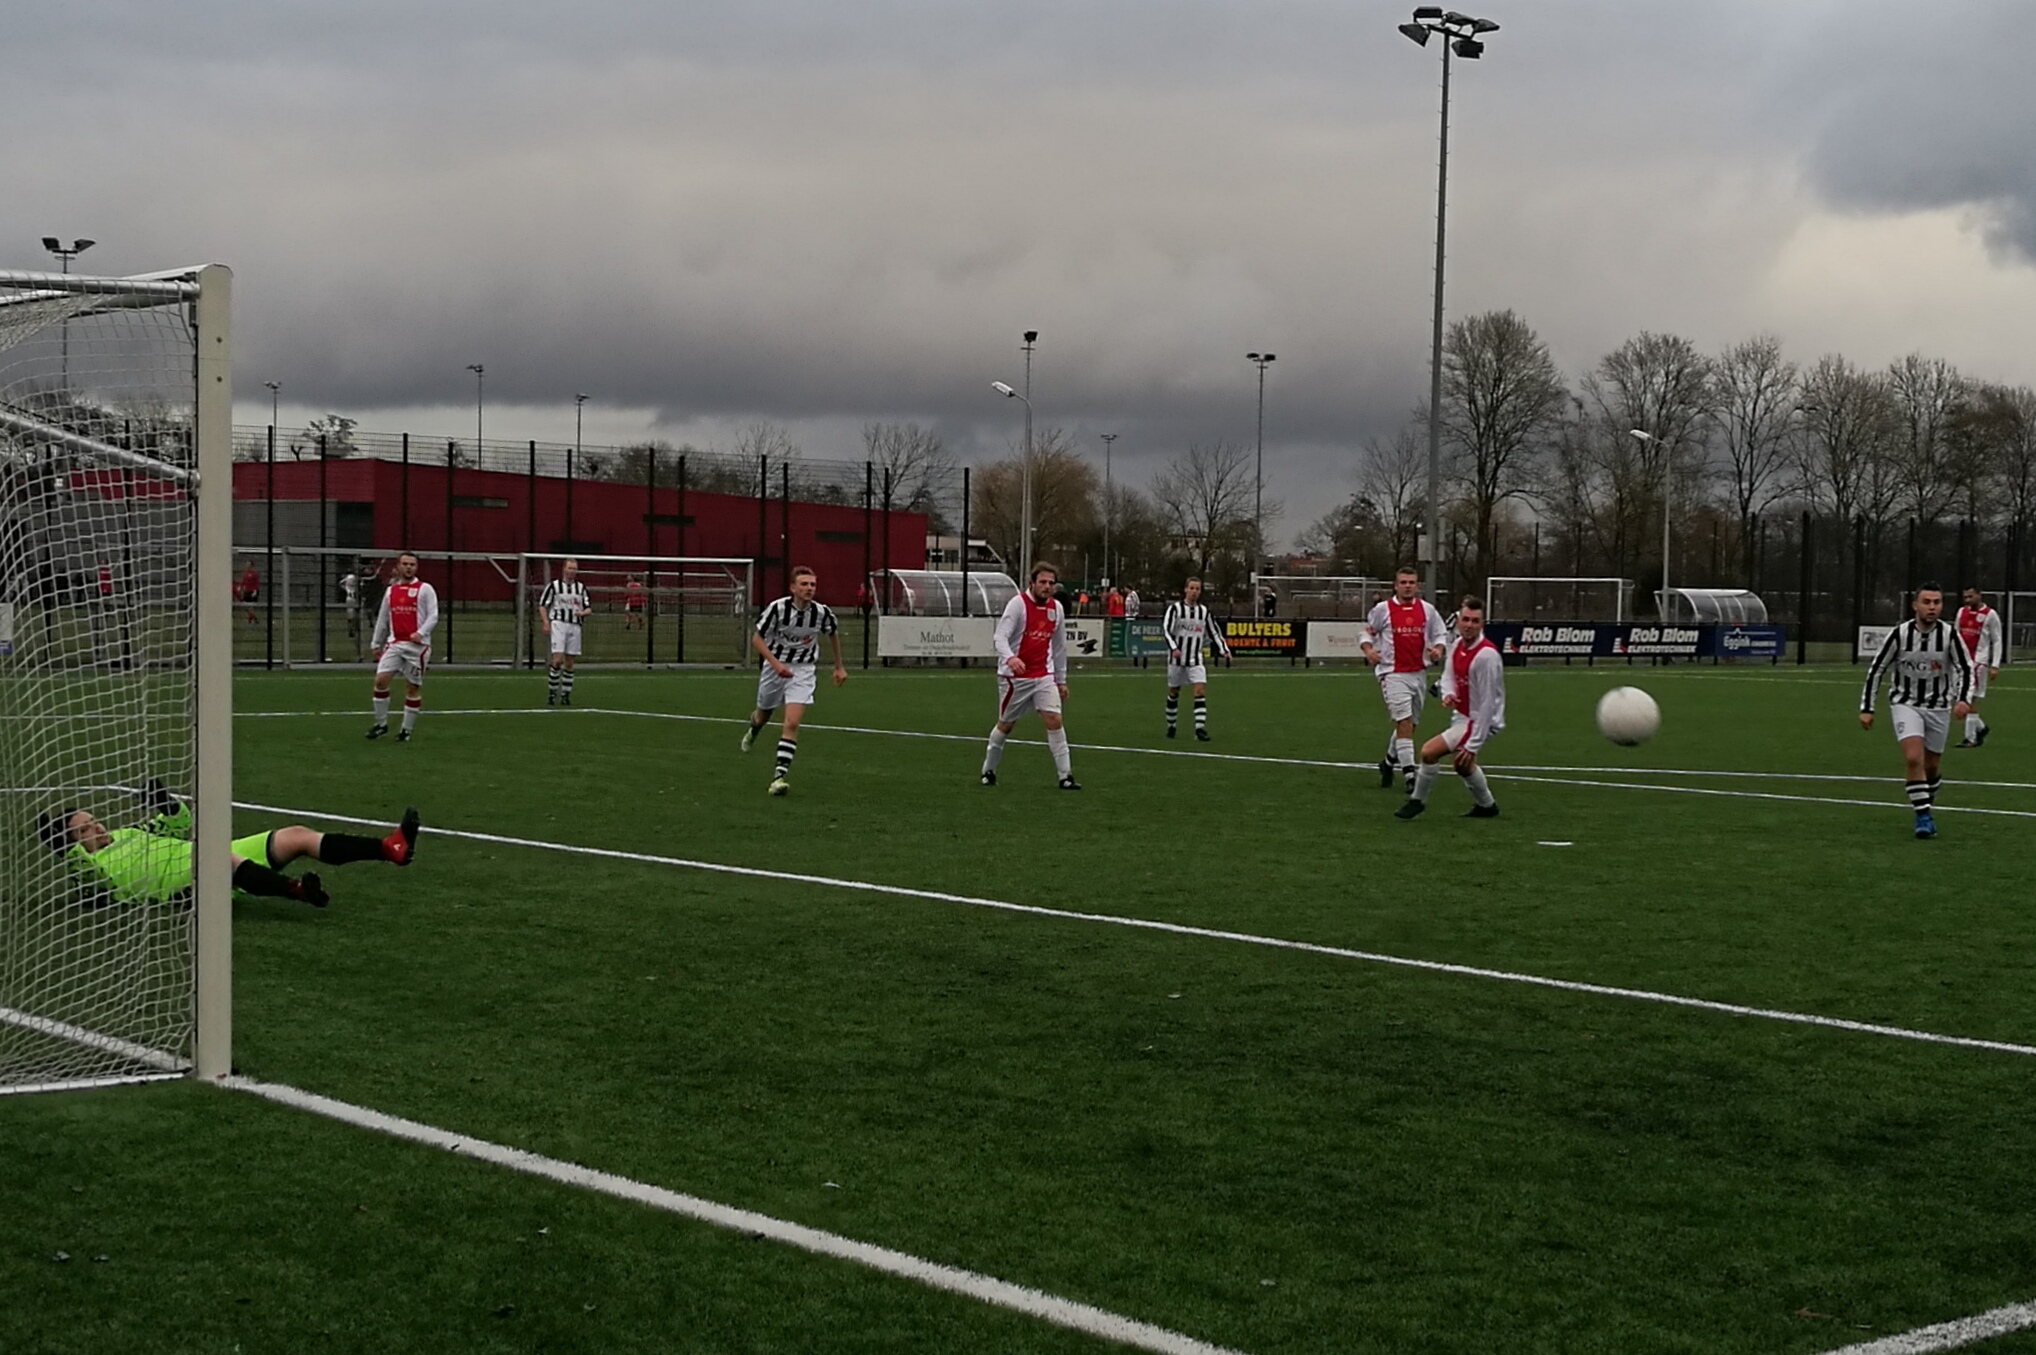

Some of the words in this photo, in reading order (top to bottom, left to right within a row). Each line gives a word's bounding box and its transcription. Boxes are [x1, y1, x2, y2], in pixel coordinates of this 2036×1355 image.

[1131, 625, 1142, 635] DE
[1226, 622, 1292, 636] BULTERS
[1521, 627, 1553, 642] Rob
[1555, 627, 1596, 642] Blom
[1629, 627, 1660, 642] Rob
[1661, 627, 1699, 642] Blom
[920, 631, 954, 643] Mathot
[1078, 631, 1088, 640] BV
[1226, 638, 1260, 647] ROENTE
[1271, 638, 1296, 647] FRUIT
[1723, 635, 1751, 650] Eggink
[1519, 645, 1593, 653] ELEKTROTECHNIEK
[1627, 645, 1697, 653] ELEKTROTECHNIEK
